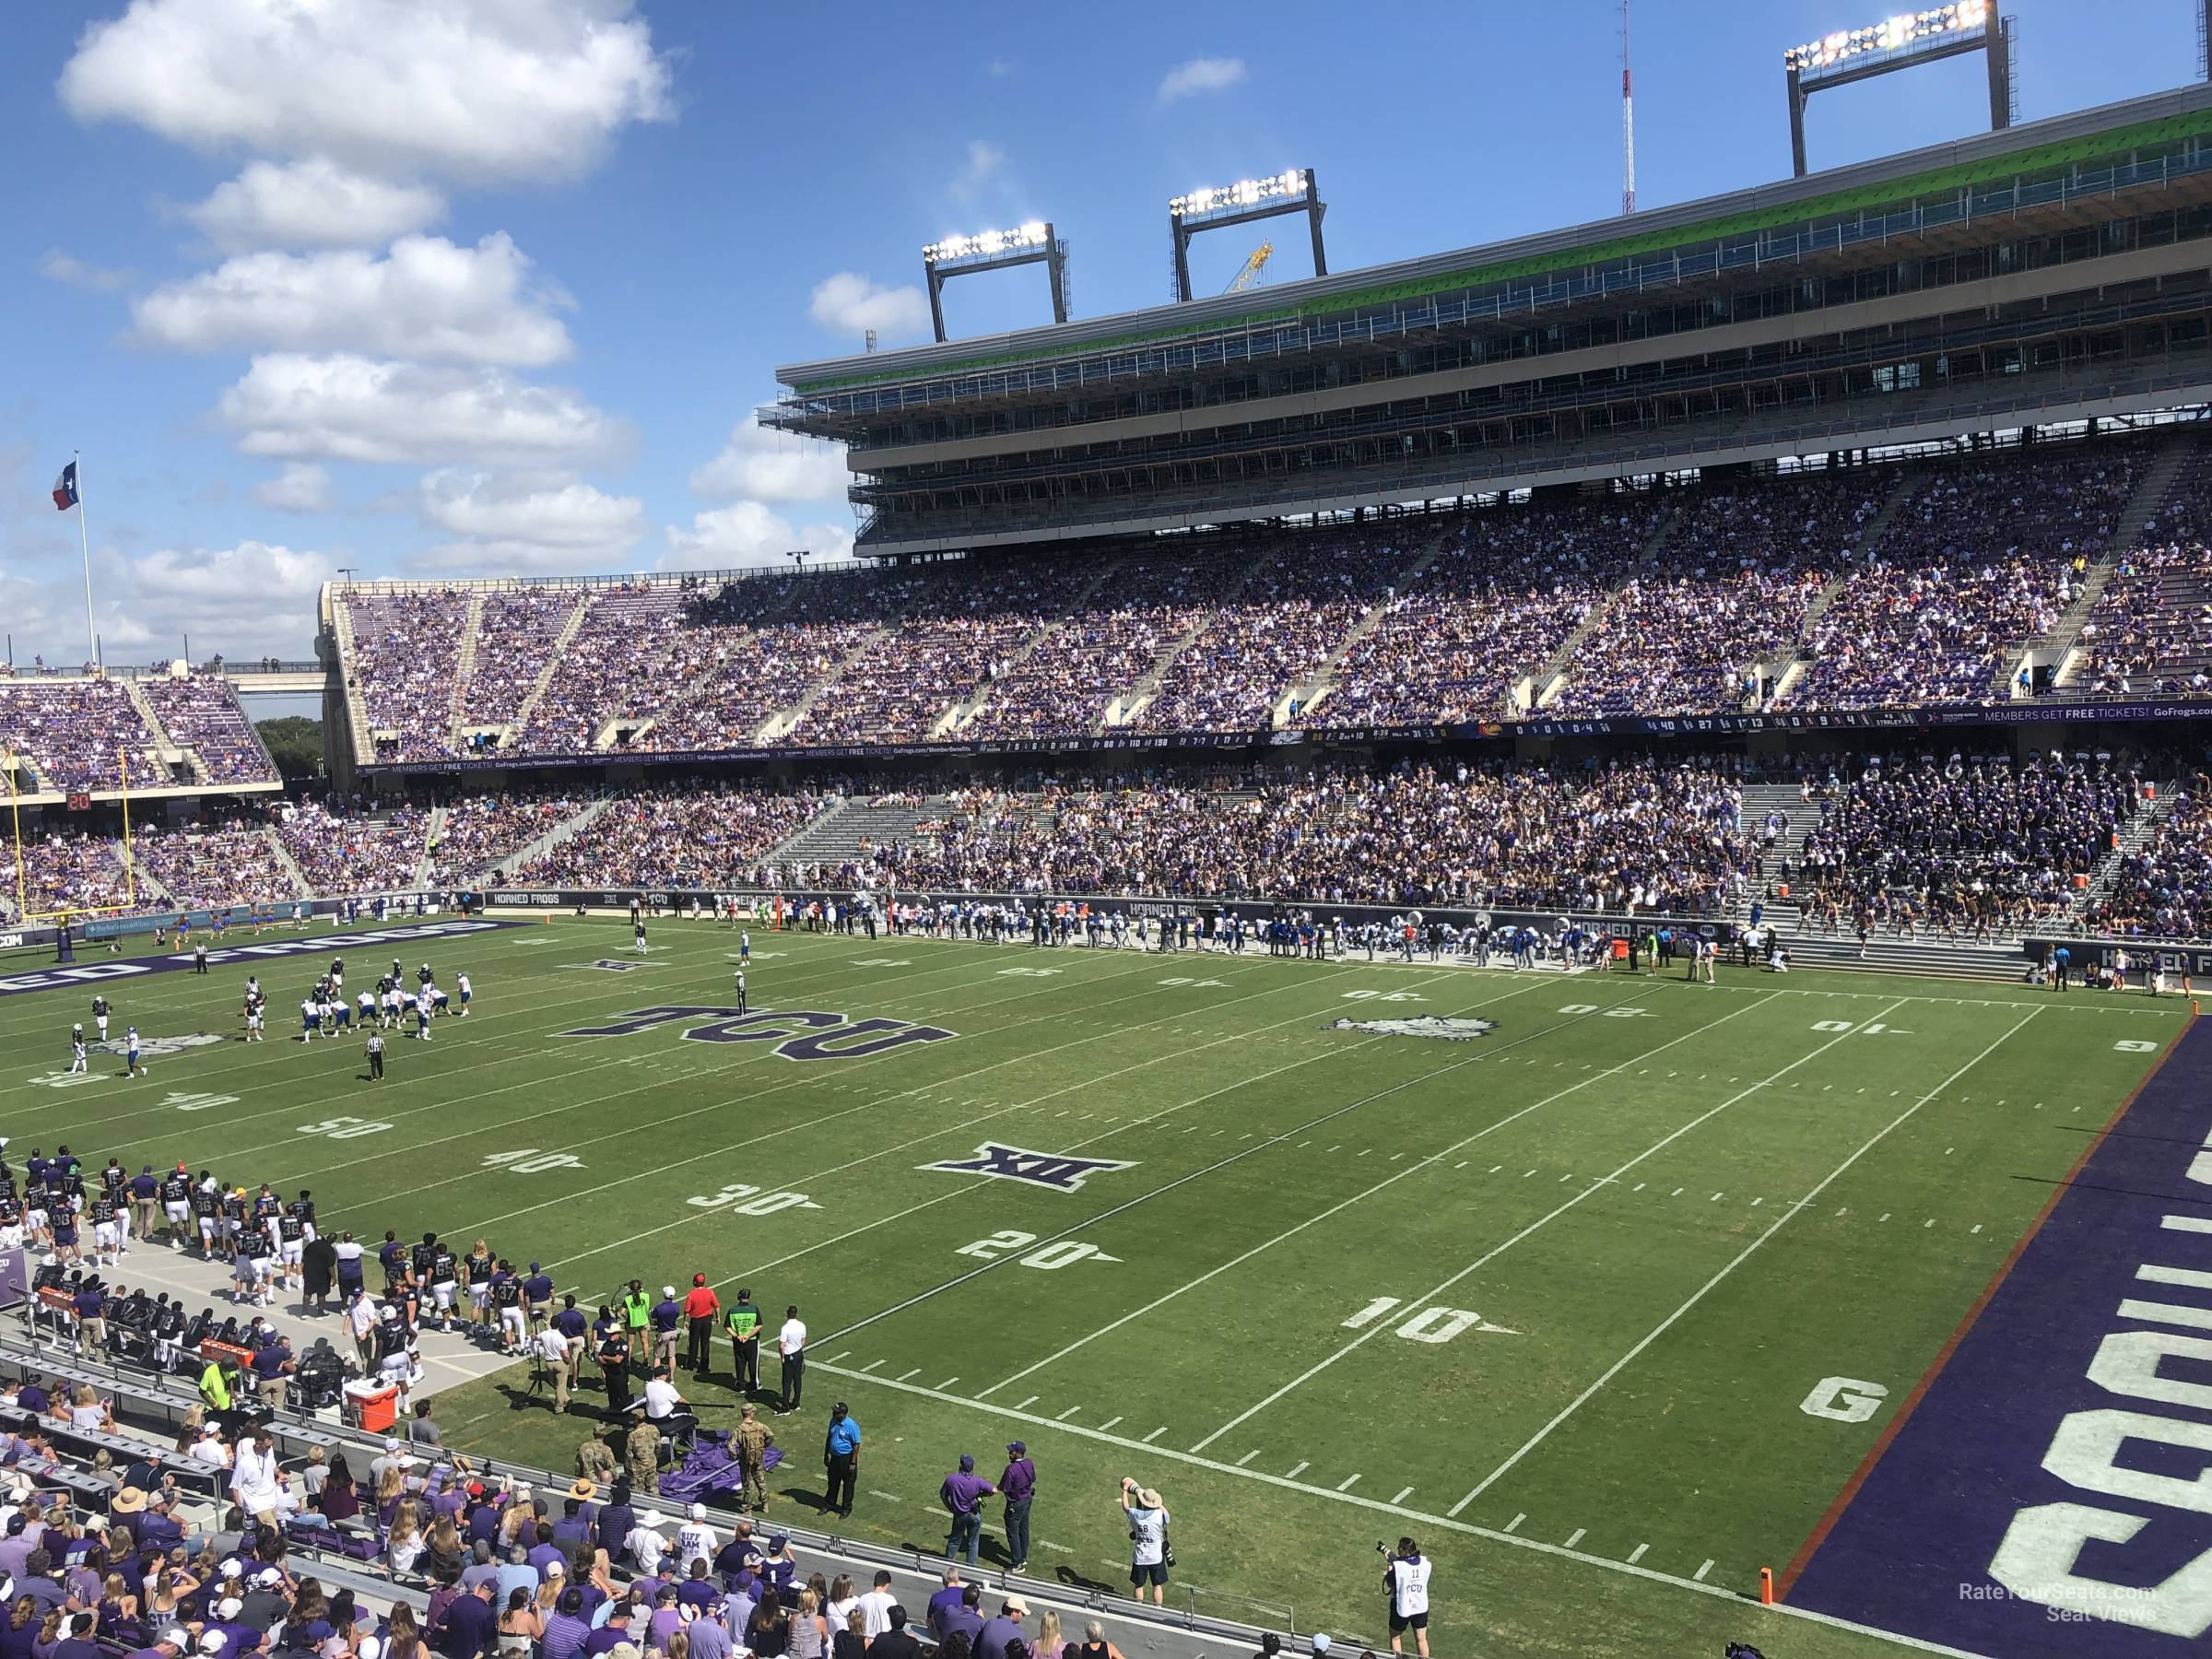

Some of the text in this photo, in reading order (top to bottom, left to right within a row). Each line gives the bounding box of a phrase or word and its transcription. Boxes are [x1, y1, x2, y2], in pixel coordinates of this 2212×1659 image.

[1846, 715, 1855, 725] 4
[1985, 711, 2039, 722] MEMBERS
[2041, 710, 2064, 720] GET
[2065, 709, 2095, 719] FREE
[2097, 707, 2149, 718] TICKETS!
[1660, 720, 1675, 730] 40
[1698, 720, 1712, 729] 27
[614, 754, 642, 763] MEMBERS
[655, 753, 670, 762] FREE
[671, 753, 695, 761] TICKETS!
[697, 752, 771, 760] GoFrogs.com/MemberBenefits
[806, 748, 835, 757] MEMBERS
[849, 747, 864, 755] FREE
[865, 747, 892, 755] TICKETS!
[893, 746, 971, 754] GoFrogs.com/MemberBenefits
[392, 765, 427, 773] MEMBERS
[428, 764, 442, 772] GET
[463, 762, 494, 771] TICKETS!
[495, 758, 577, 769] GoFrogs.com/MemberBenefits
[70, 794, 89, 810] 20
[494, 894, 559, 905] HORNED FROGS
[648, 895, 668, 905] TCU
[1130, 903, 1174, 916] HORNED
[1341, 990, 1423, 1002] 30
[1557, 1004, 1646, 1018] 20
[546, 1005, 960, 1062] TCU
[296, 1116, 394, 1140] 50
[479, 1148, 579, 1174] 40
[165, 1186, 183, 1198] 55
[686, 1183, 810, 1216] 30
[95, 1208, 112, 1220] 85
[247, 1238, 264, 1253] 27
[953, 1230, 1100, 1270] 20
[435, 1260, 453, 1277] 65
[471, 1258, 490, 1273] 72
[498, 1284, 517, 1300] 37
[1340, 1296, 1482, 1343] 10
[1799, 1375, 1889, 1424] G
[770, 1570, 777, 1583] 1
[1412, 1569, 1419, 1578] 11
[1406, 1584, 1423, 1594] TCU
